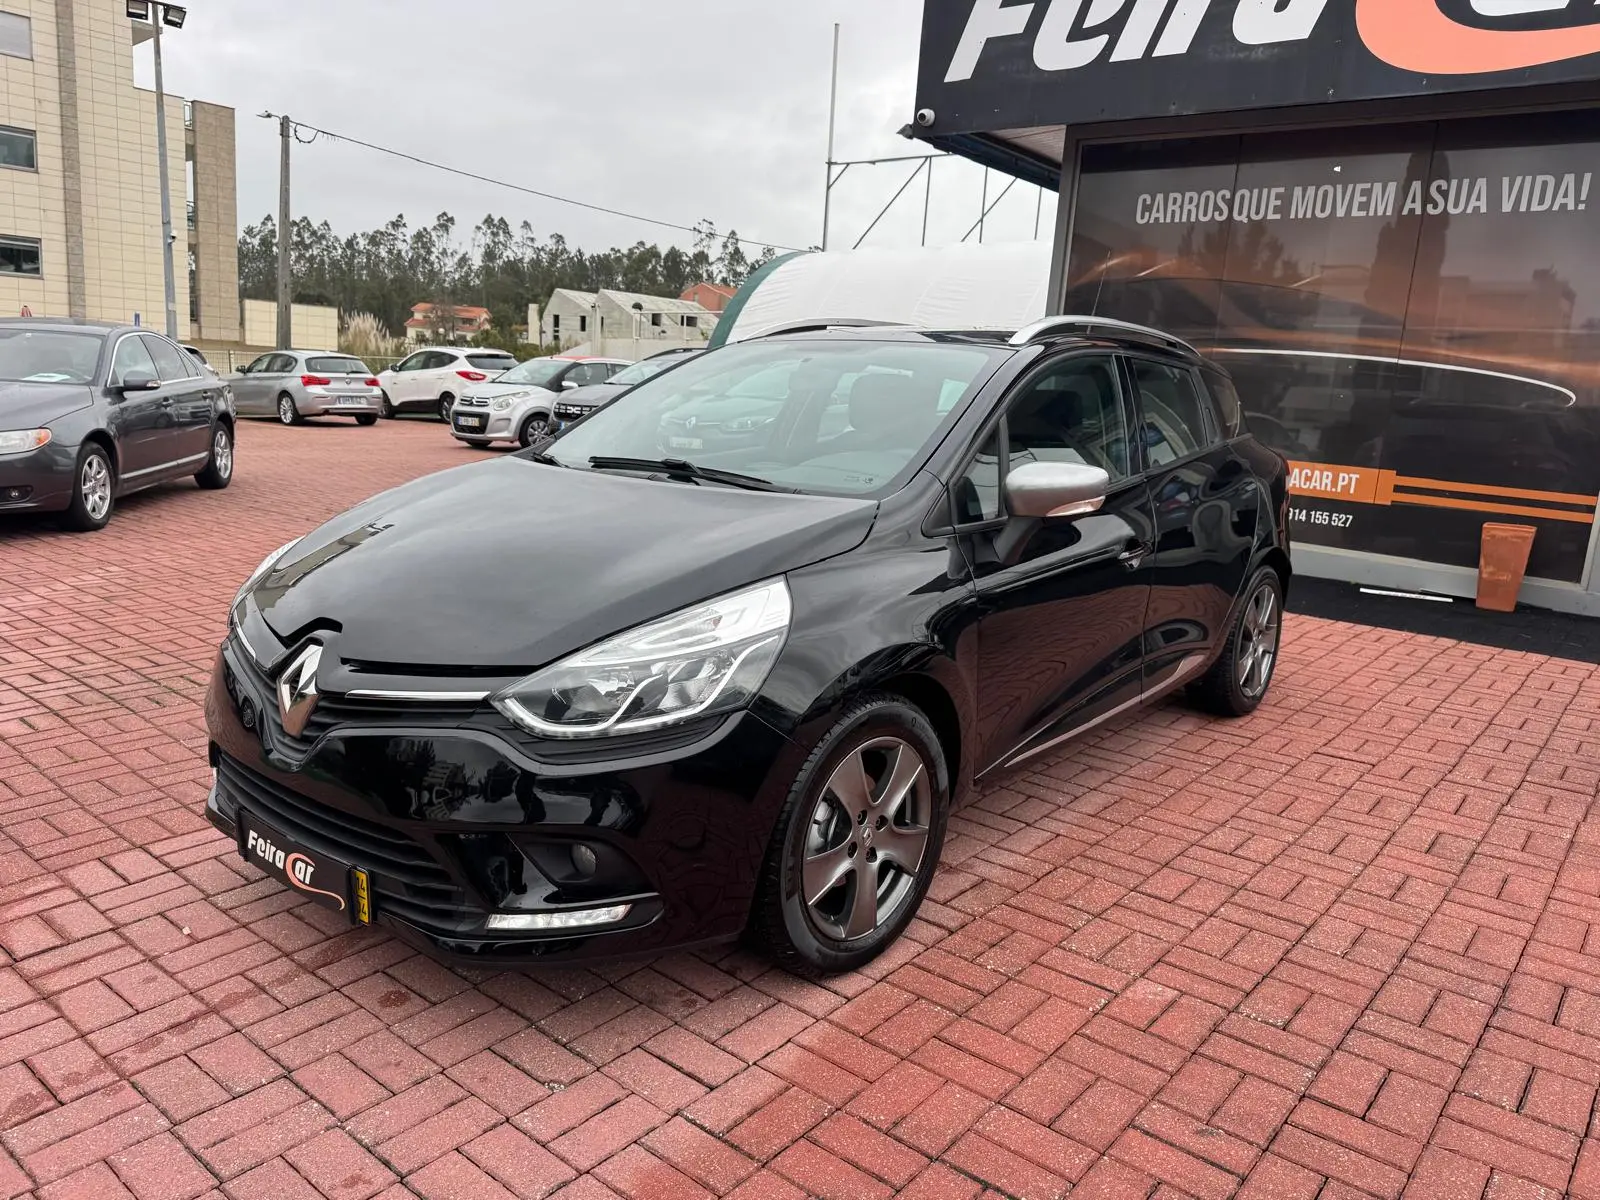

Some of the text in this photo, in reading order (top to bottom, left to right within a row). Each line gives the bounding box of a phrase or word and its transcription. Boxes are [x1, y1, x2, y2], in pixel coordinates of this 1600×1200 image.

[1135, 172, 1593, 225] CARROS QUE MOVEM A SUA VIDA!
[1309, 510, 1330, 525] 155
[1331, 513, 1353, 528] 527
